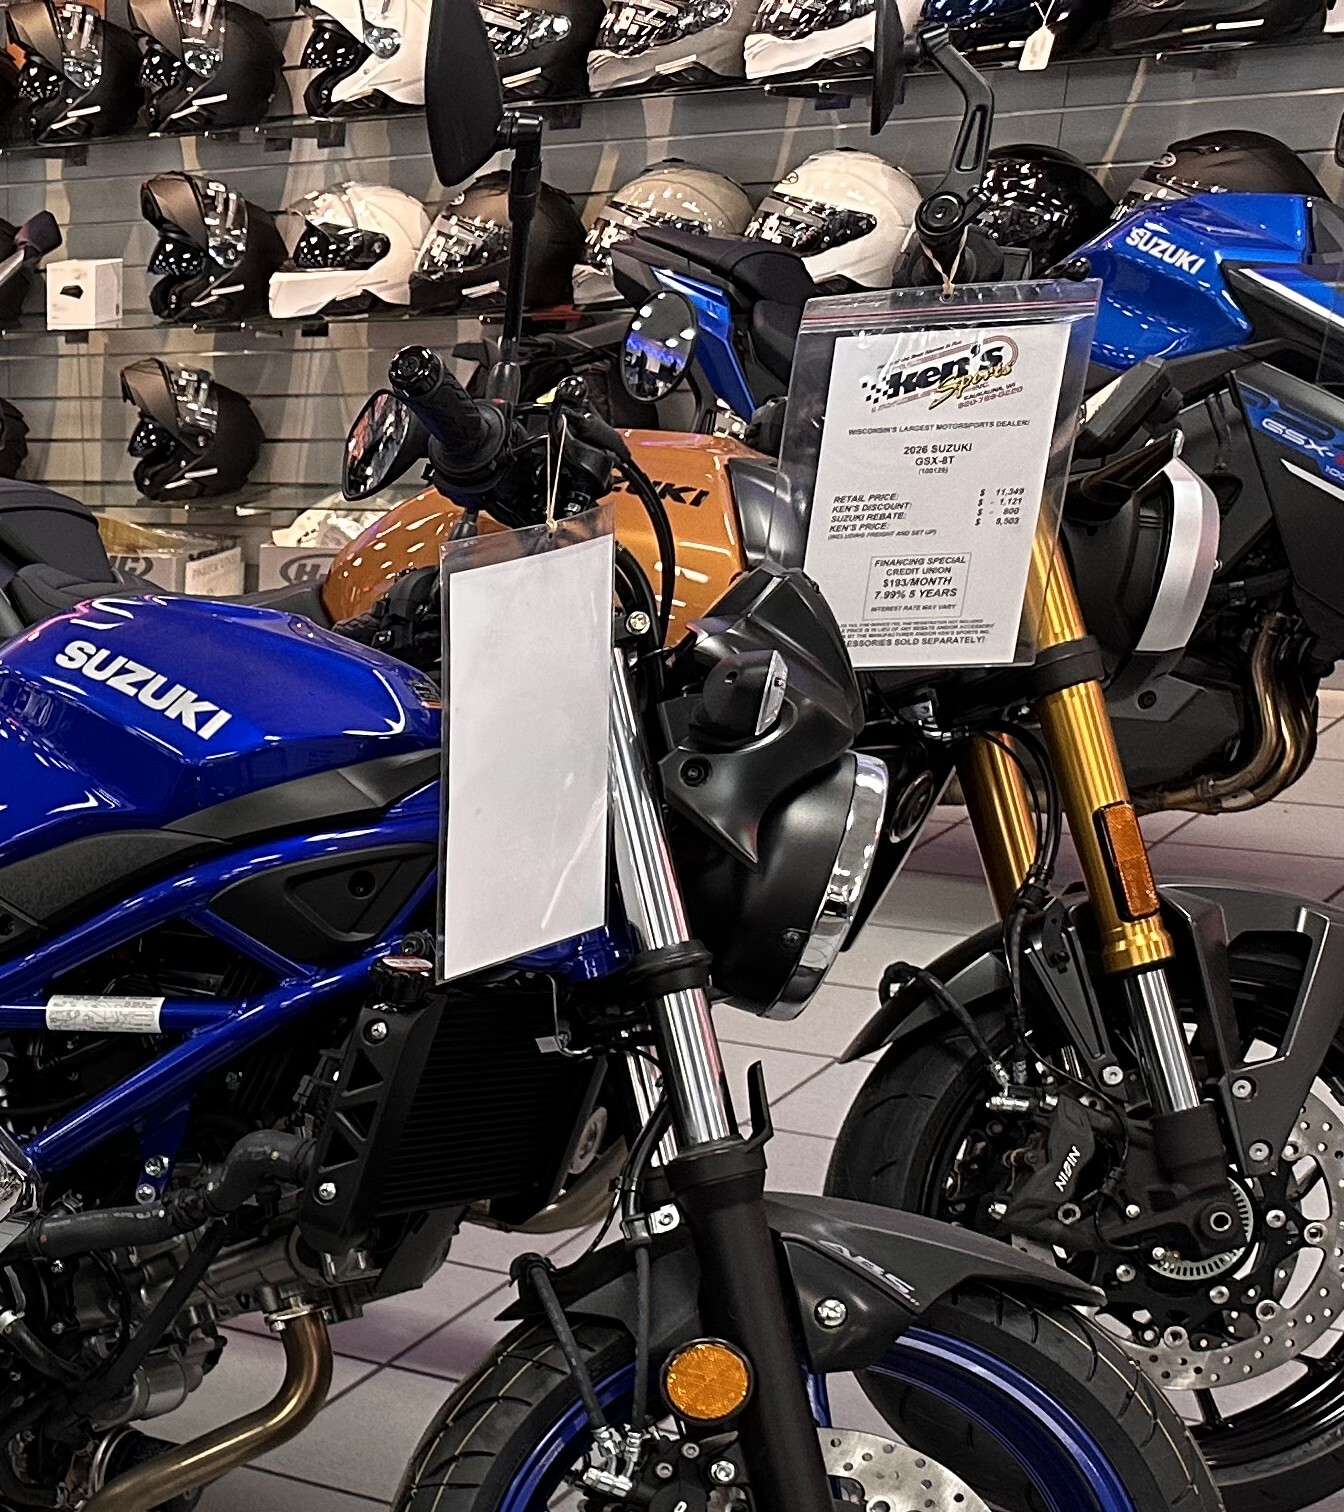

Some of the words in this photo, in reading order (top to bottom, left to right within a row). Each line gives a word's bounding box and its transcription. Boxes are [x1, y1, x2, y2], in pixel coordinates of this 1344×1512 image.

[1125, 226, 1206, 274] SUZUKI
[899, 424, 935, 433] LARGEST
[936, 421, 995, 431] MOTORSPORTS
[1262, 417, 1344, 466] GSX-
[903, 445, 928, 455] 2026
[931, 443, 972, 453] SUZUKI
[915, 456, 955, 466] GSX-8T
[834, 494, 864, 504] RETAIL
[868, 493, 899, 502] PRICE:
[832, 503, 860, 513] KEN'S
[831, 513, 863, 523] SUZUKI
[829, 523, 856, 533] KEN'S
[858, 522, 890, 531] PRICE:
[874, 558, 925, 566] FINANCING
[927, 556, 967, 565] SPECIAL
[886, 567, 920, 576] CREDIT
[919, 588, 957, 597] YEARS
[843, 638, 892, 647] ESSORIES
[921, 636, 986, 645] SEPARATELY!
[55, 640, 233, 740] SUZUKI
